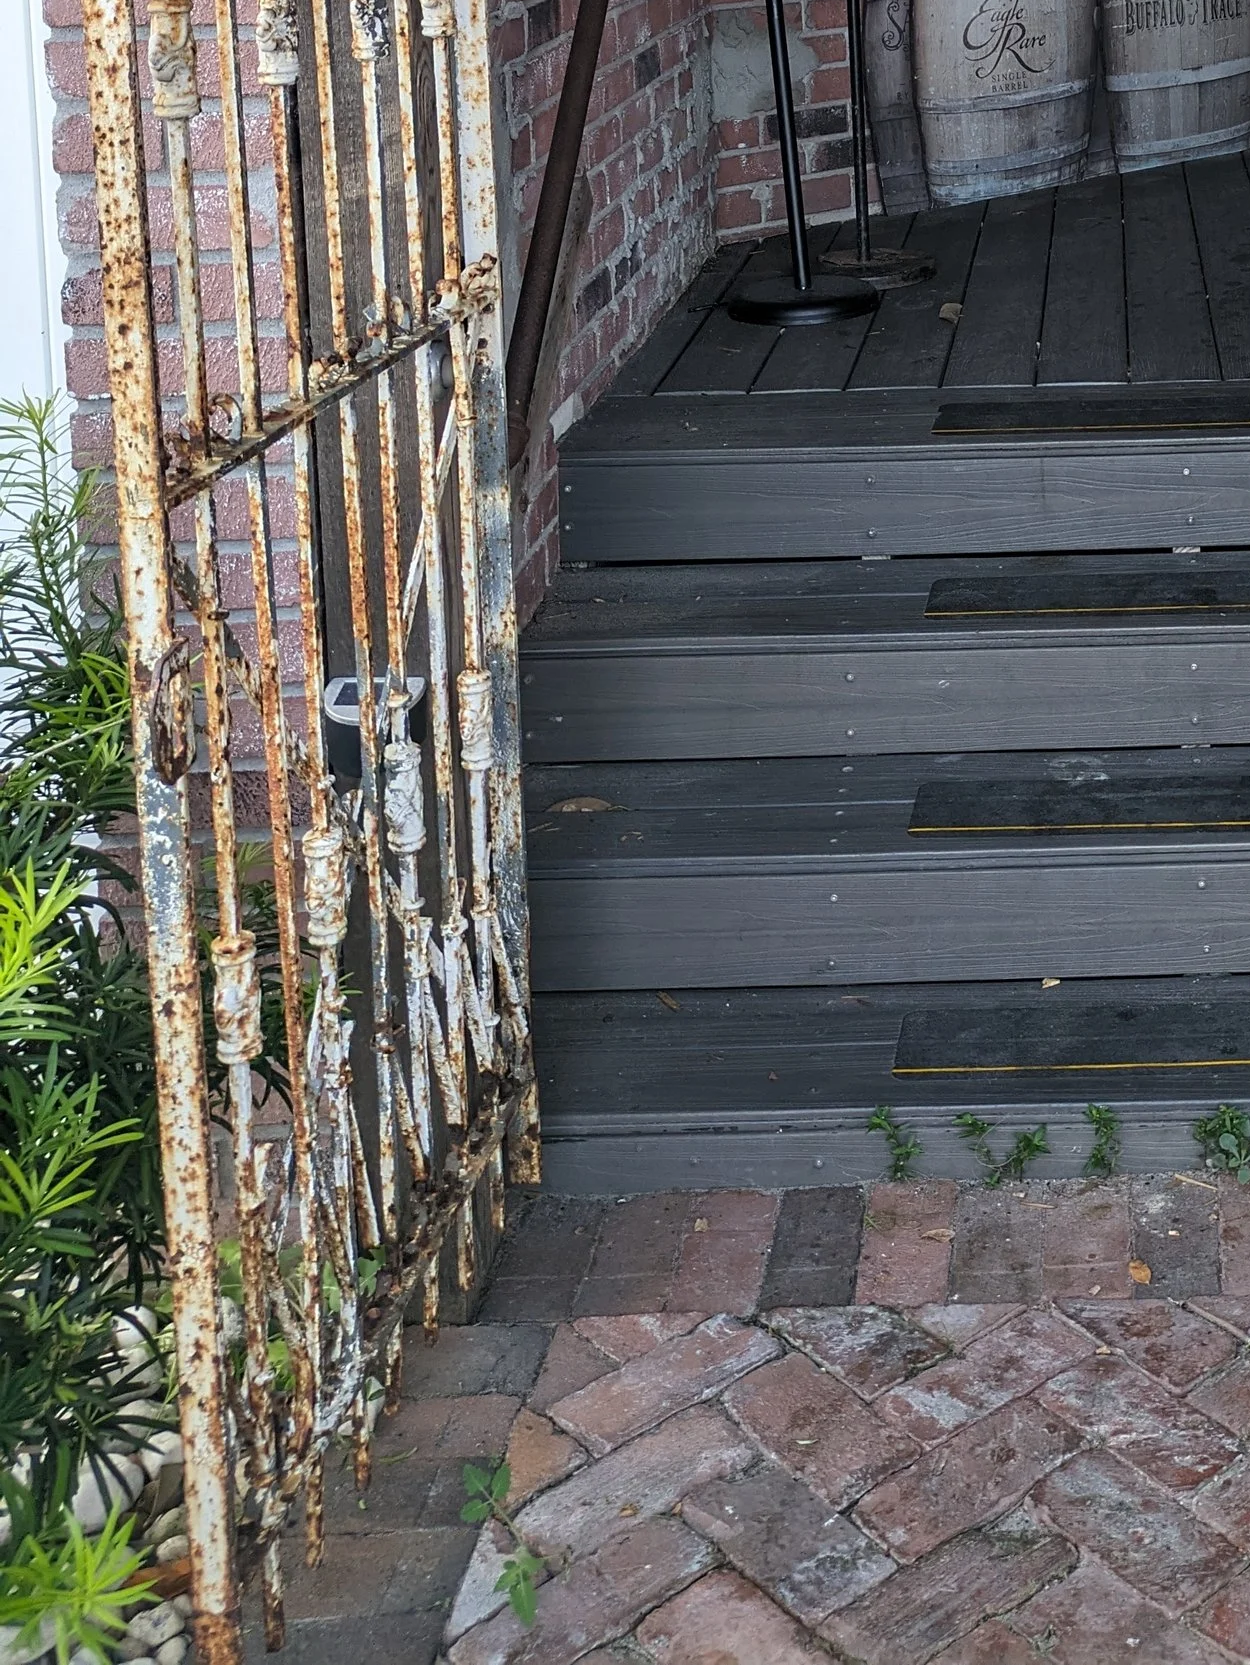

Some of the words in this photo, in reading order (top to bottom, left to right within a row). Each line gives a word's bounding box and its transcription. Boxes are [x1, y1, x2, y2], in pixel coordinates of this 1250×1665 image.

[975, 22, 1056, 79] Rare
[991, 70, 1028, 84] SINGLE
[991, 81, 1029, 94] BARREL
